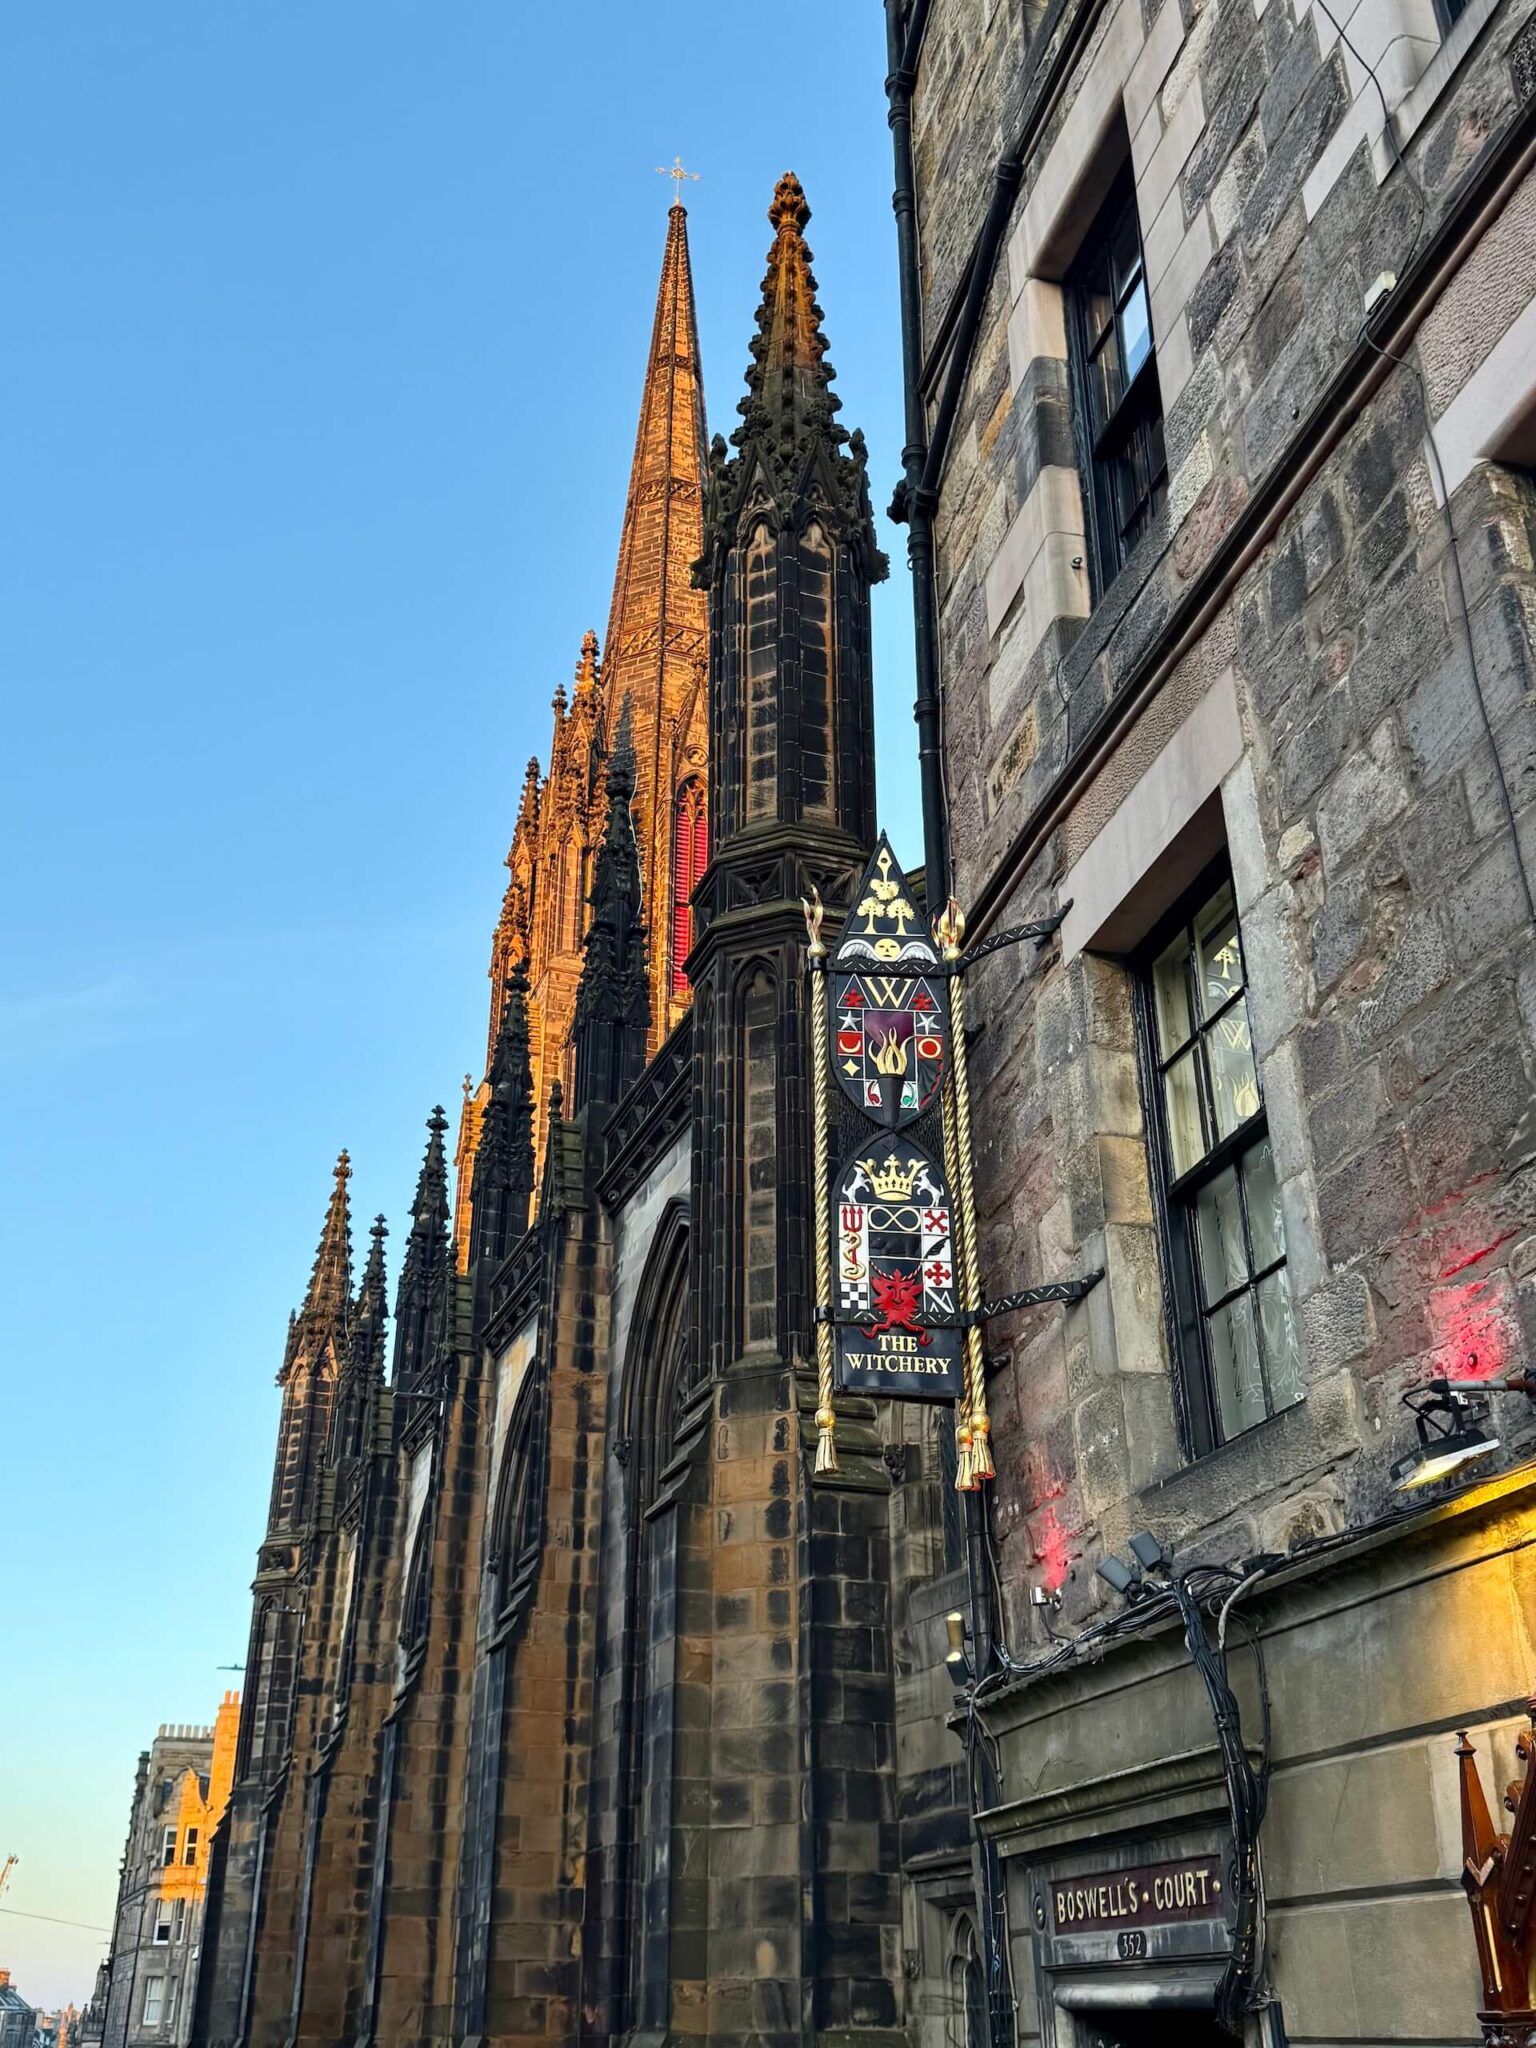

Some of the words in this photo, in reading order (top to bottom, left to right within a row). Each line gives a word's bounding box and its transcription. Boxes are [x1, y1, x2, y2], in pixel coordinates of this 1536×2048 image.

[862, 976, 914, 1009] W
[878, 1334, 918, 1353] THE
[845, 1352, 952, 1375] WITCHERY
[1057, 1876, 1138, 1924] BOSWELL'S
[1154, 1869, 1209, 1911] COURT
[1122, 1933, 1142, 1957] 352
